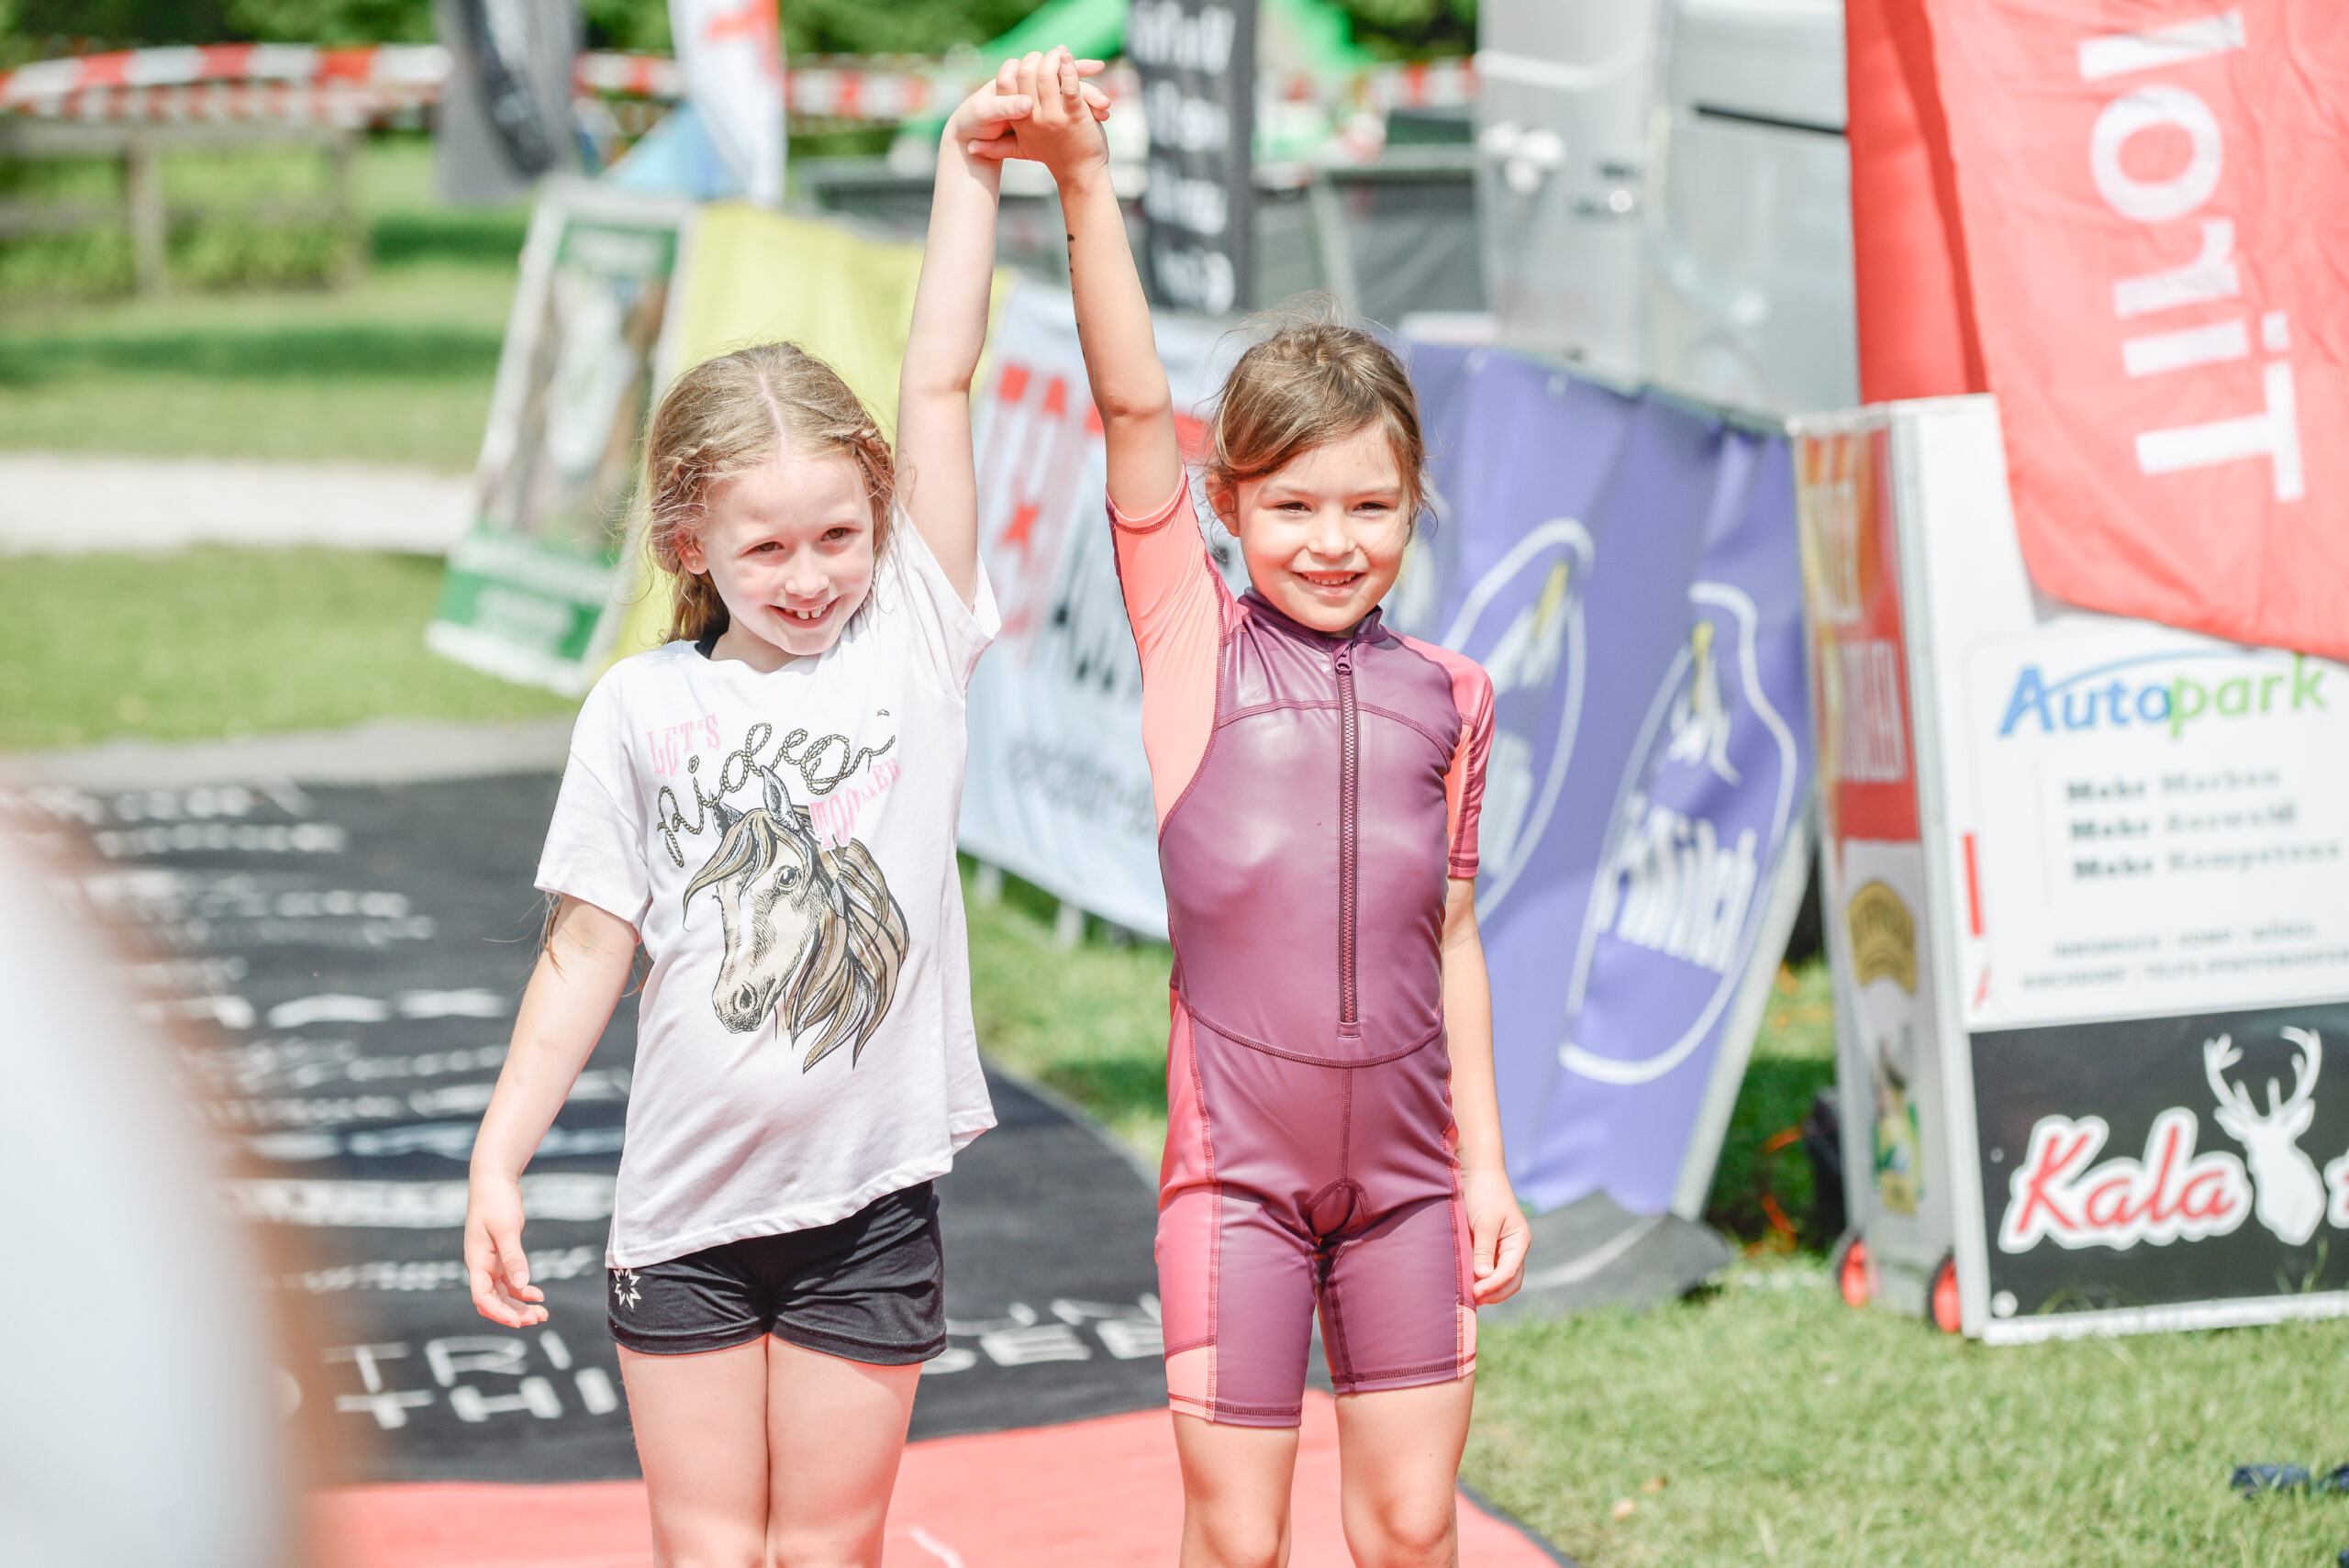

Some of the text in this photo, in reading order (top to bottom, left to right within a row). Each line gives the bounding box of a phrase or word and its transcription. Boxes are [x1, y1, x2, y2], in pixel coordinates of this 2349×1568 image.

[2076, 9, 2304, 502] Tirol
[1999, 651, 2327, 738] Autopark
[2009, 1117, 2243, 1243] Kala
